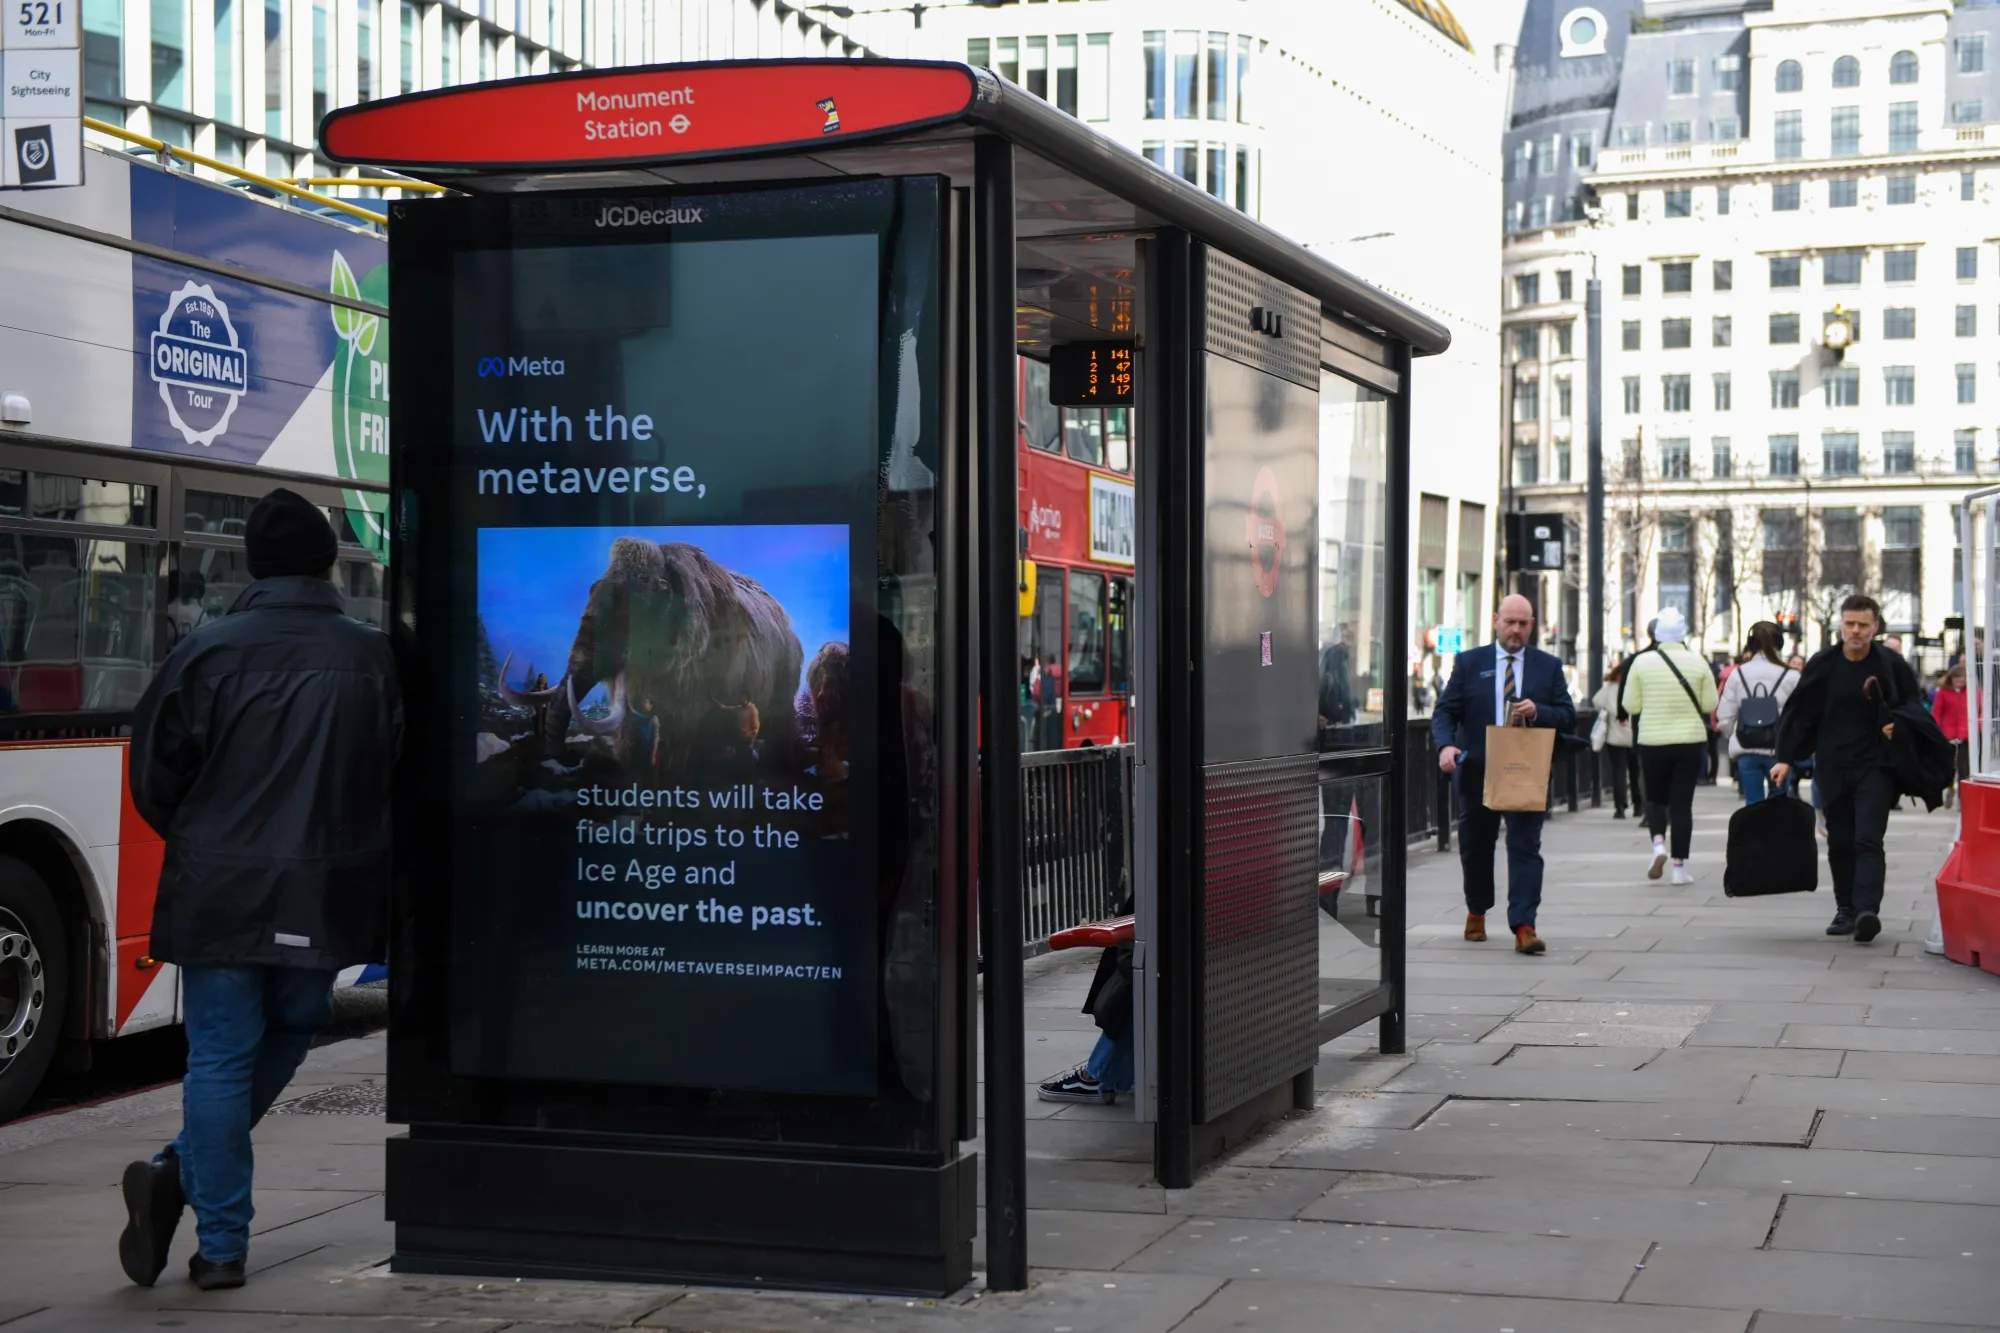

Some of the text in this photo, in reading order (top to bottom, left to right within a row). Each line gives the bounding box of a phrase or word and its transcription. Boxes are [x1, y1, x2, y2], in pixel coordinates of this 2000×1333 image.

[19, 2, 62, 26] 521
[24, 28, 56, 36] Mon-Fri
[30, 70, 51, 82] City
[11, 85, 70, 98] Sightseeing
[576, 86, 695, 112] Monument
[584, 117, 662, 140] Station
[594, 206, 703, 228] JCDecaux
[200, 301, 215, 319] 1951
[190, 320, 211, 339] The
[157, 344, 243, 384] ORIGINAL
[1092, 350, 1130, 360] 1 141
[508, 356, 566, 377] Meta
[1090, 362, 1130, 372] 2 47
[1090, 374, 1130, 384] 3 149
[188, 390, 213, 409] Tour
[1090, 385, 1130, 395] 4 17
[477, 404, 654, 443] With the
[478, 461, 706, 499] metaverse,
[576, 783, 824, 811] students will take
[576, 819, 800, 852] field trips to the
[577, 858, 735, 890] Ice Age and
[576, 898, 822, 931] uncover the past.
[576, 944, 666, 957] LEARN MORE AT
[576, 957, 842, 980] META.COM/METAVERSEIMPACT/EN
